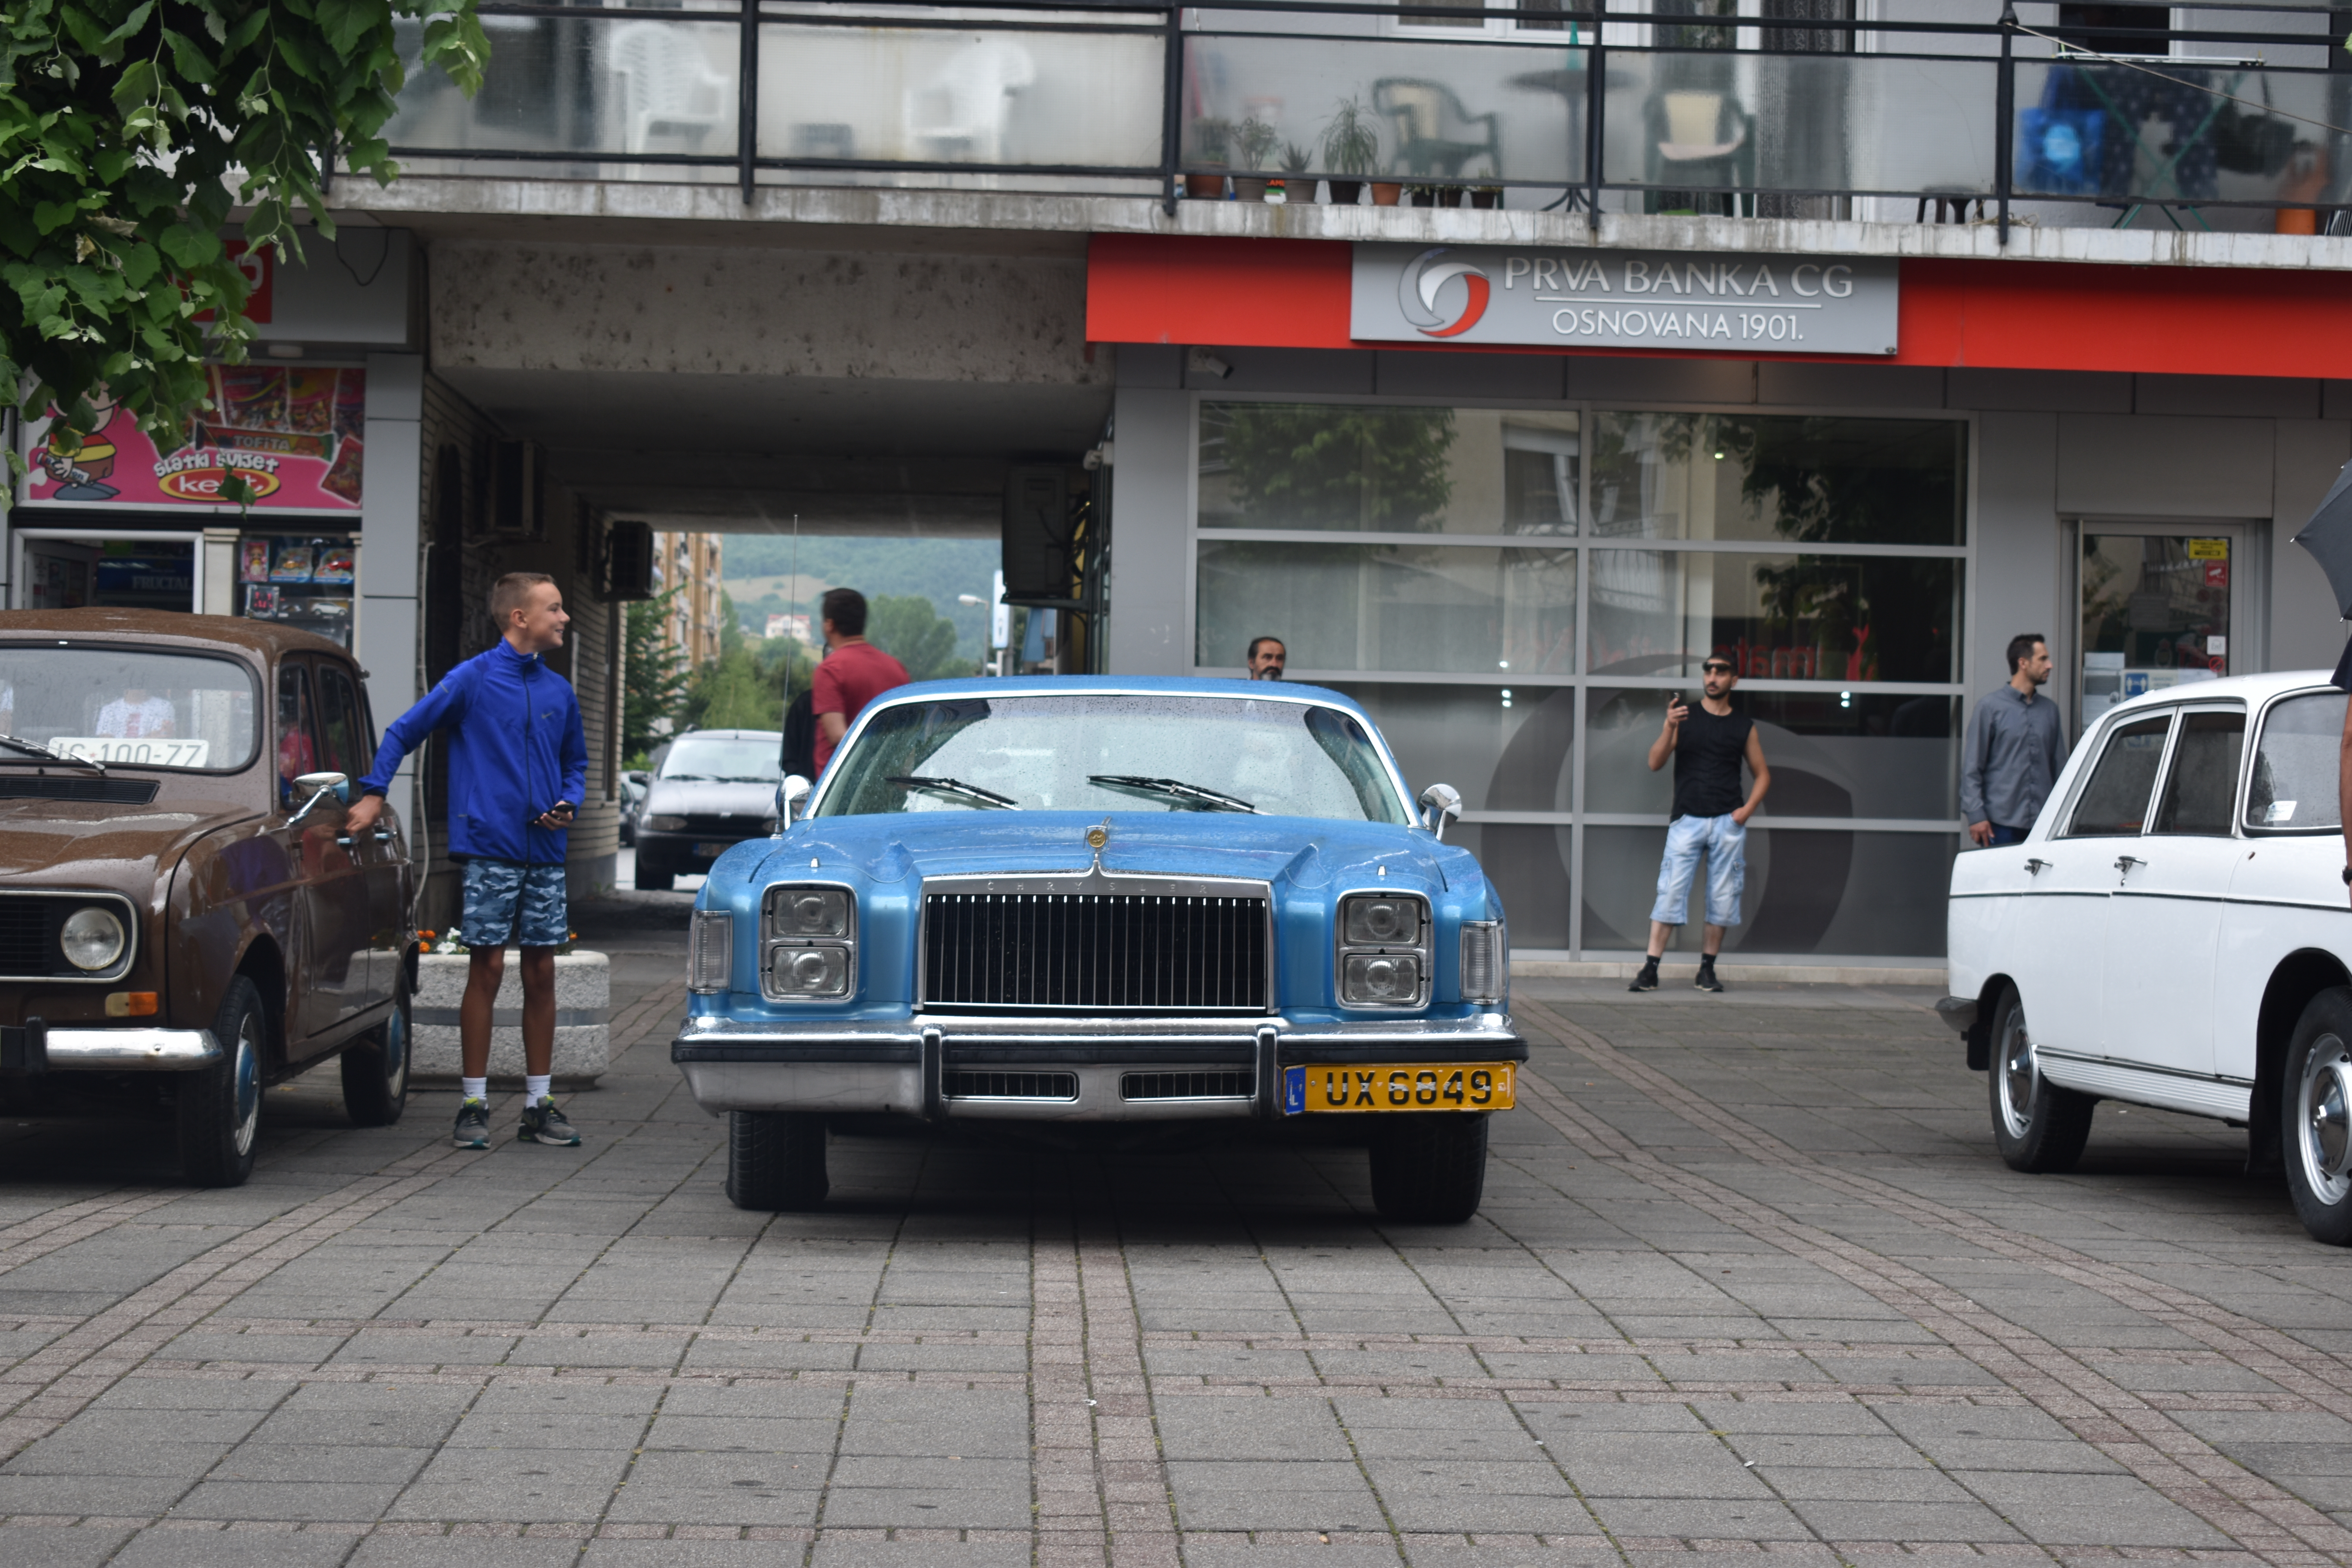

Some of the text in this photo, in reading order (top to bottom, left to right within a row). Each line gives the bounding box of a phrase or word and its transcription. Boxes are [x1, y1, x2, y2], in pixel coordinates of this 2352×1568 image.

[1505, 258, 1853, 298] PRVA BANKA CG
[1552, 309, 1803, 340] OSNOVANA 1901.
[179, 475, 264, 493] ket
[132, 576, 192, 589] FRUCTAL
[987, 882, 1207, 893] CHRYSLER
[1327, 1070, 1491, 1105] UX 6849
